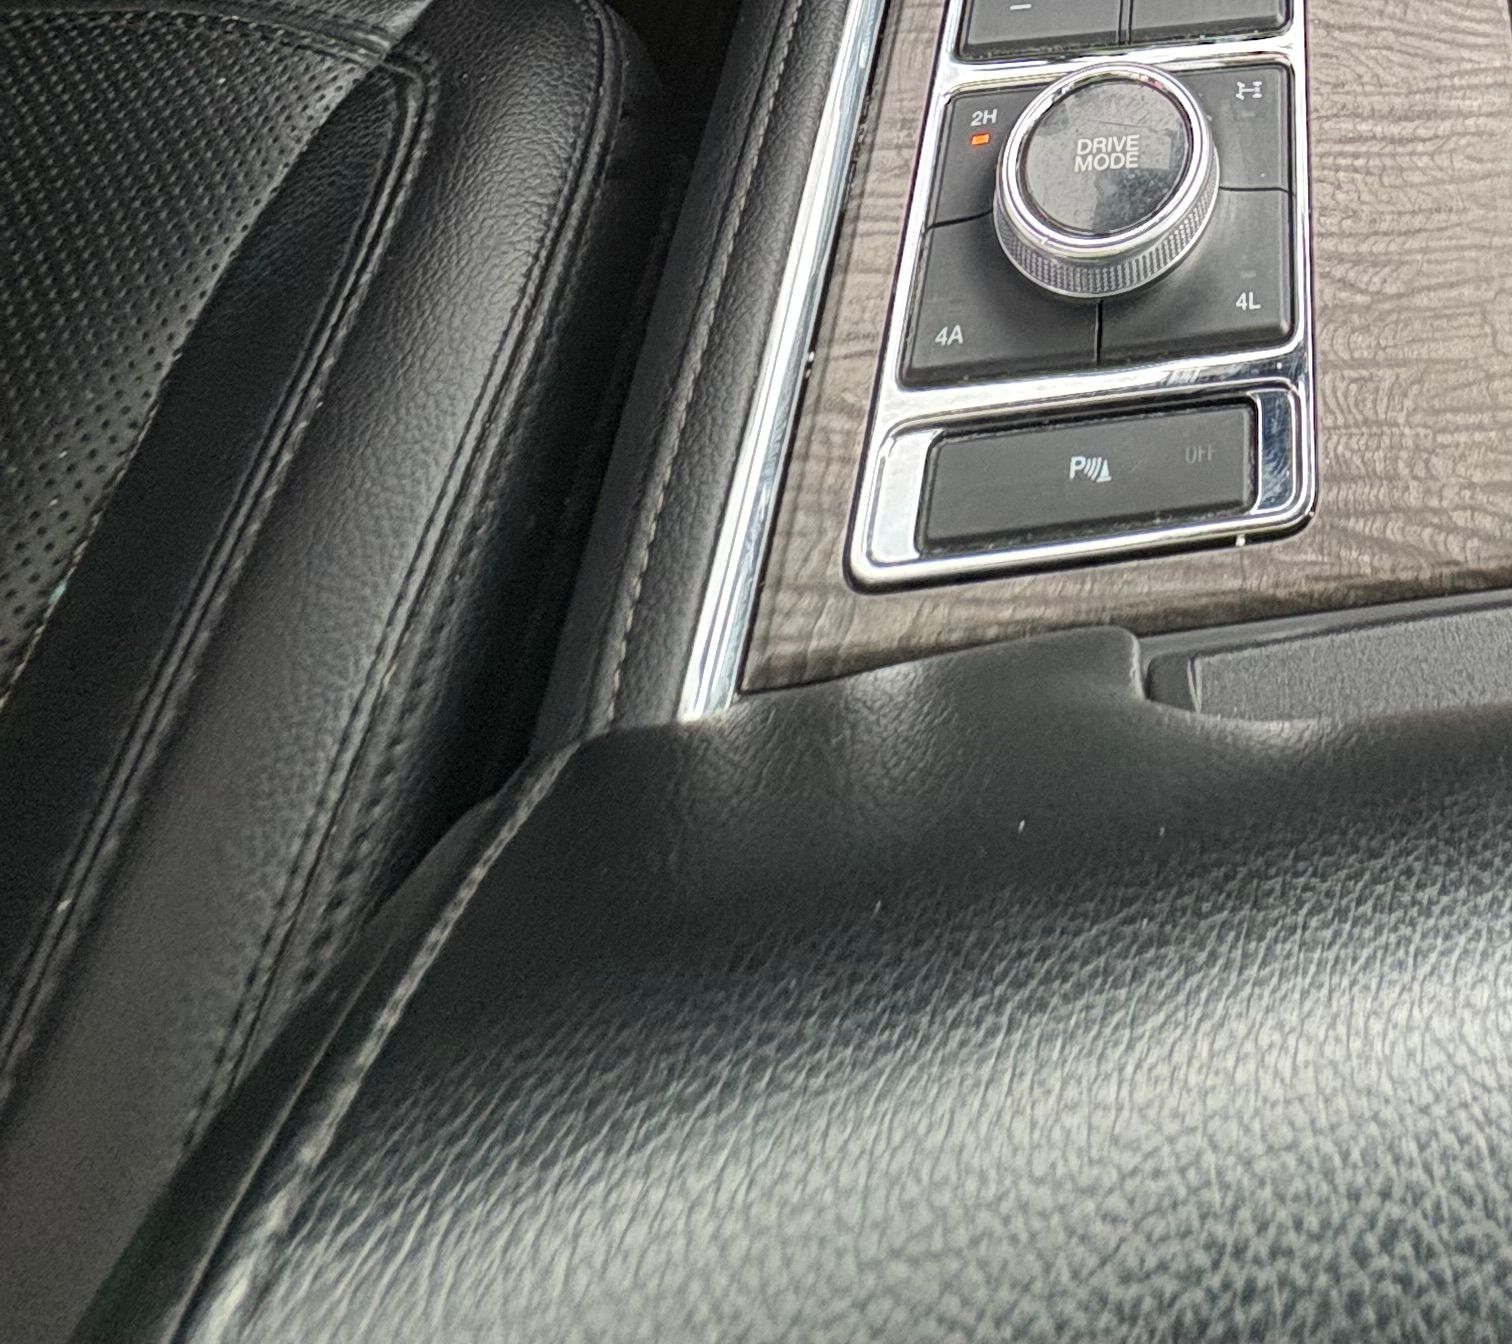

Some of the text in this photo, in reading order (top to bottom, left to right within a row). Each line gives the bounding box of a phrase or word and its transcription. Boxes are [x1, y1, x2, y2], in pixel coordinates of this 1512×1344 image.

[971, 109, 998, 127] 2H
[1076, 134, 1140, 155] DRIVE
[1074, 152, 1139, 173] MODE
[1235, 291, 1262, 311] 4L
[935, 324, 963, 345] 4A
[1185, 445, 1216, 464] OFF
